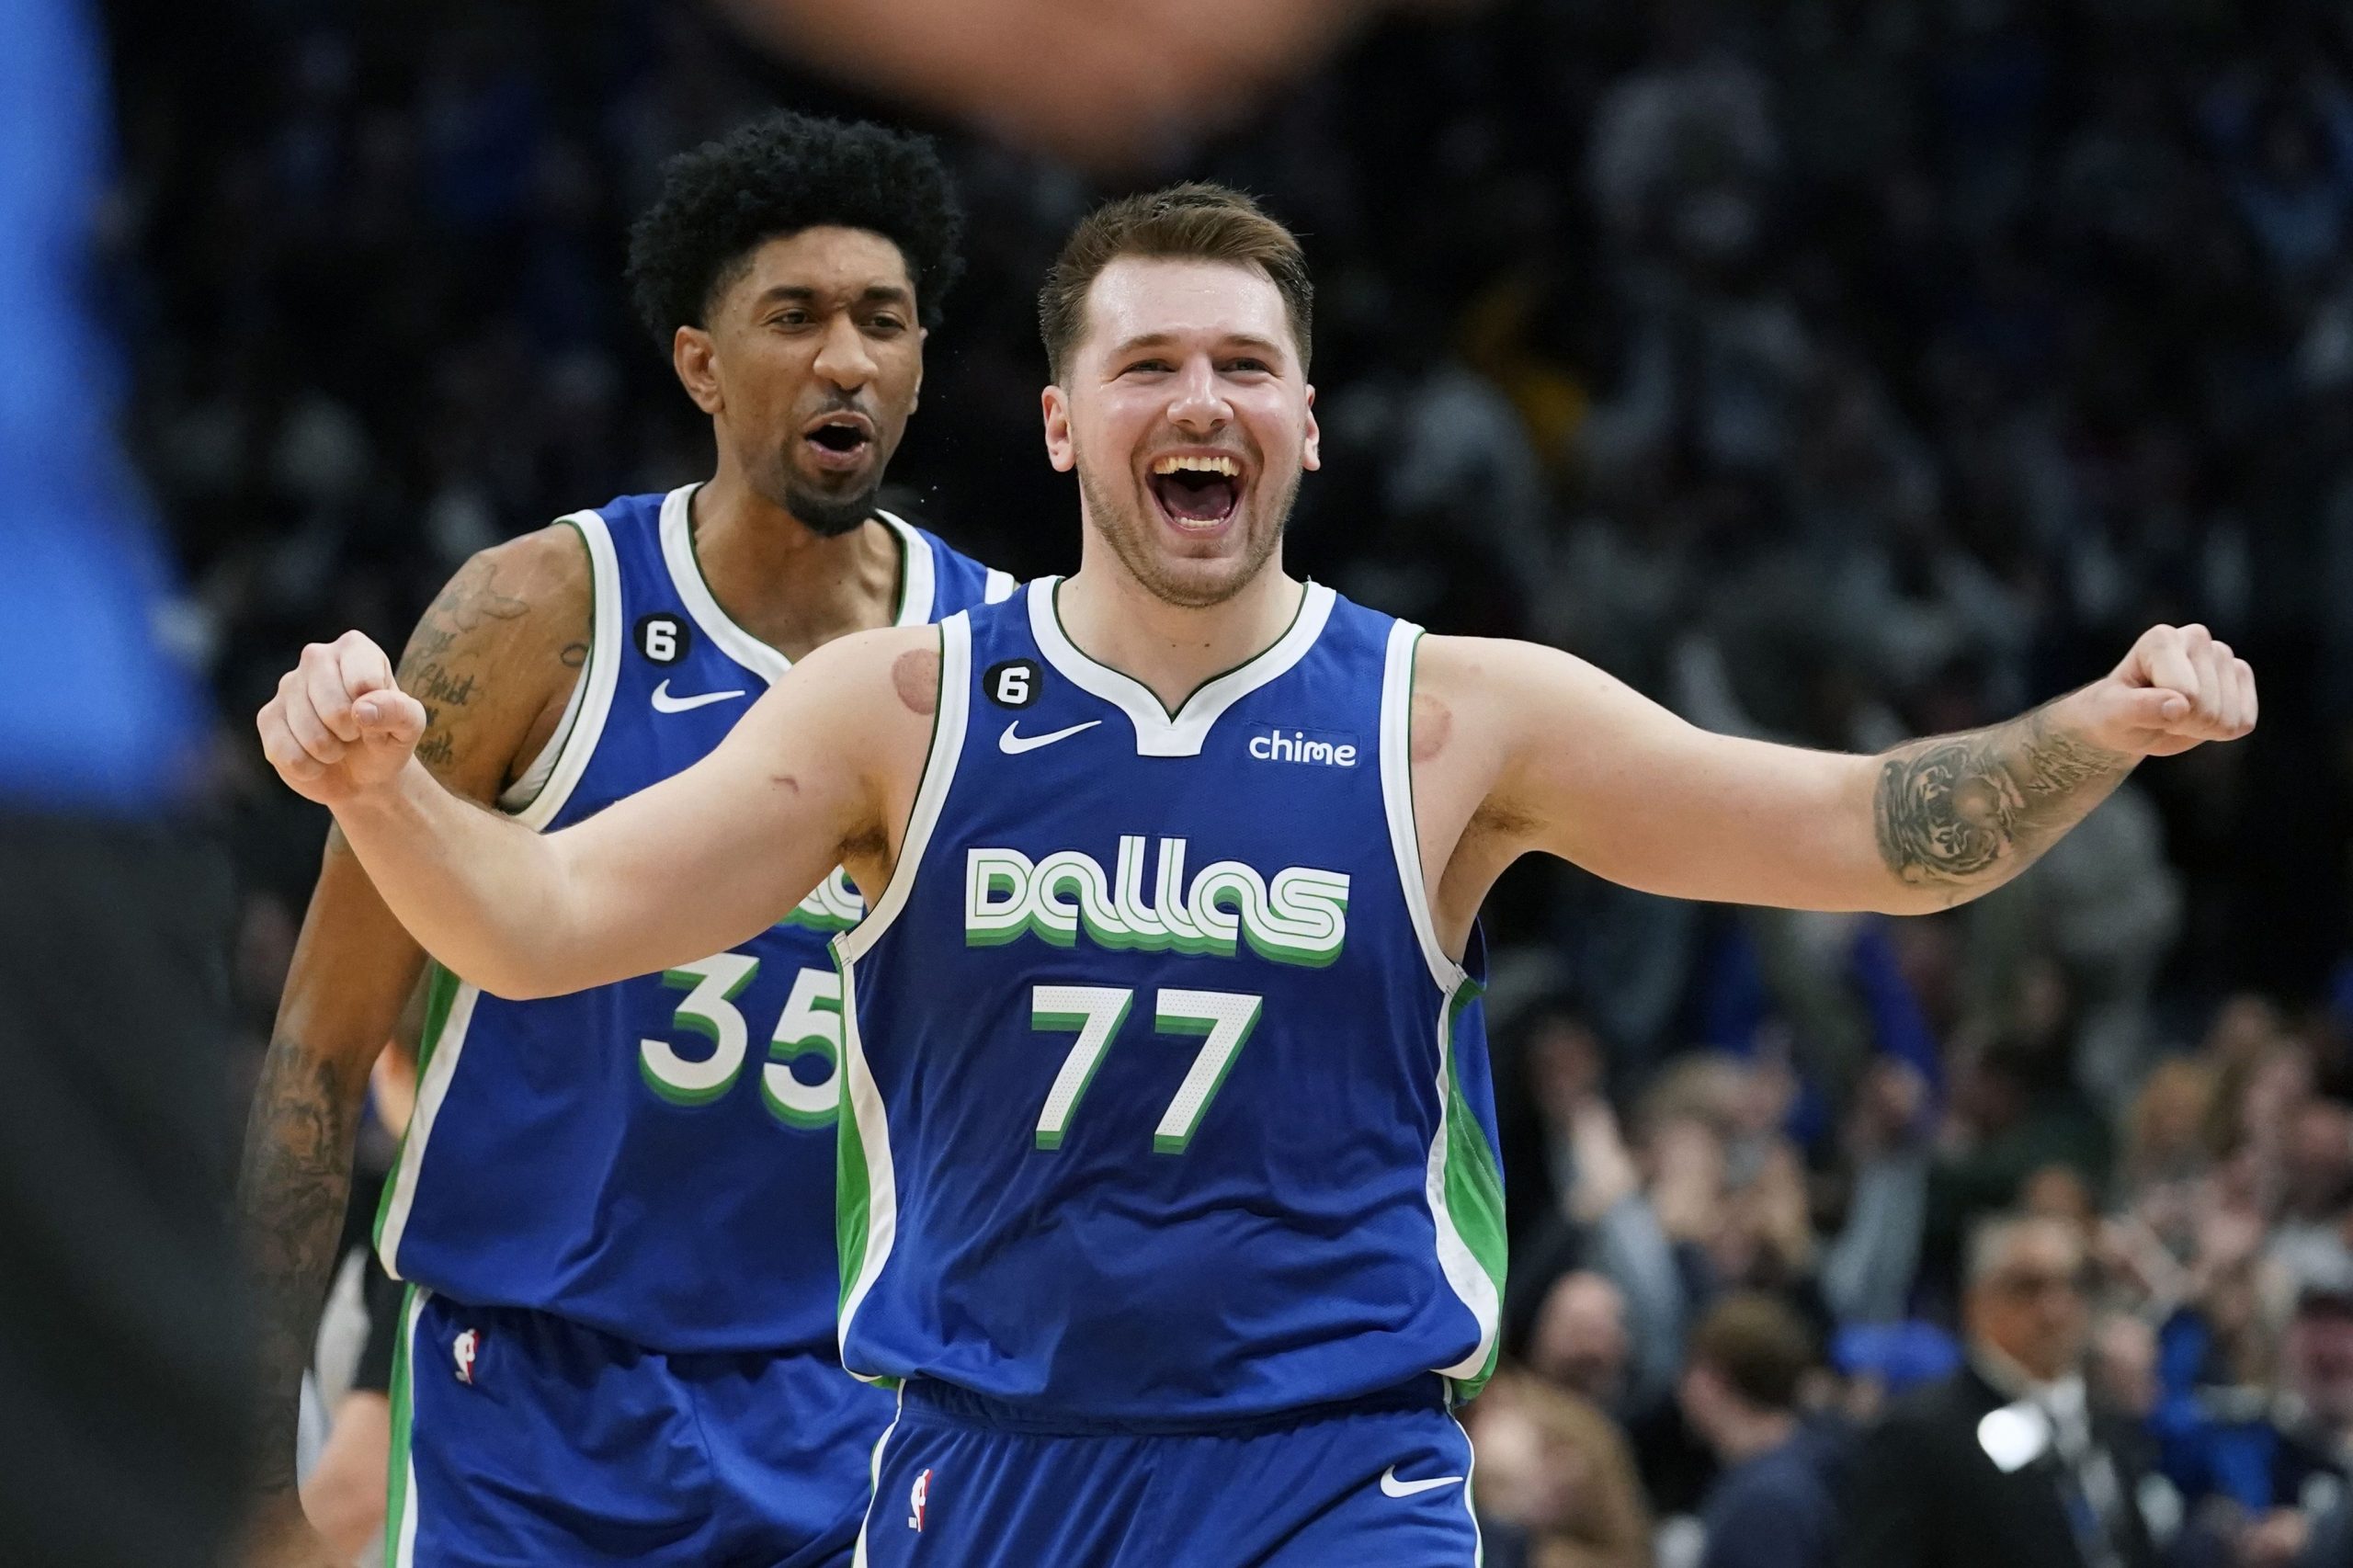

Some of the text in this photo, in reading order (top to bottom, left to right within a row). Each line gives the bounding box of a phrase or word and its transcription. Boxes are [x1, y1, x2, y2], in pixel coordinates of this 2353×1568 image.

[645, 619, 676, 661] 6
[997, 665, 1029, 704] 6
[1249, 730, 1357, 767] chime
[965, 835, 1351, 969] Dallas
[639, 950, 843, 1130] 35
[1031, 984, 1263, 1153] 77
